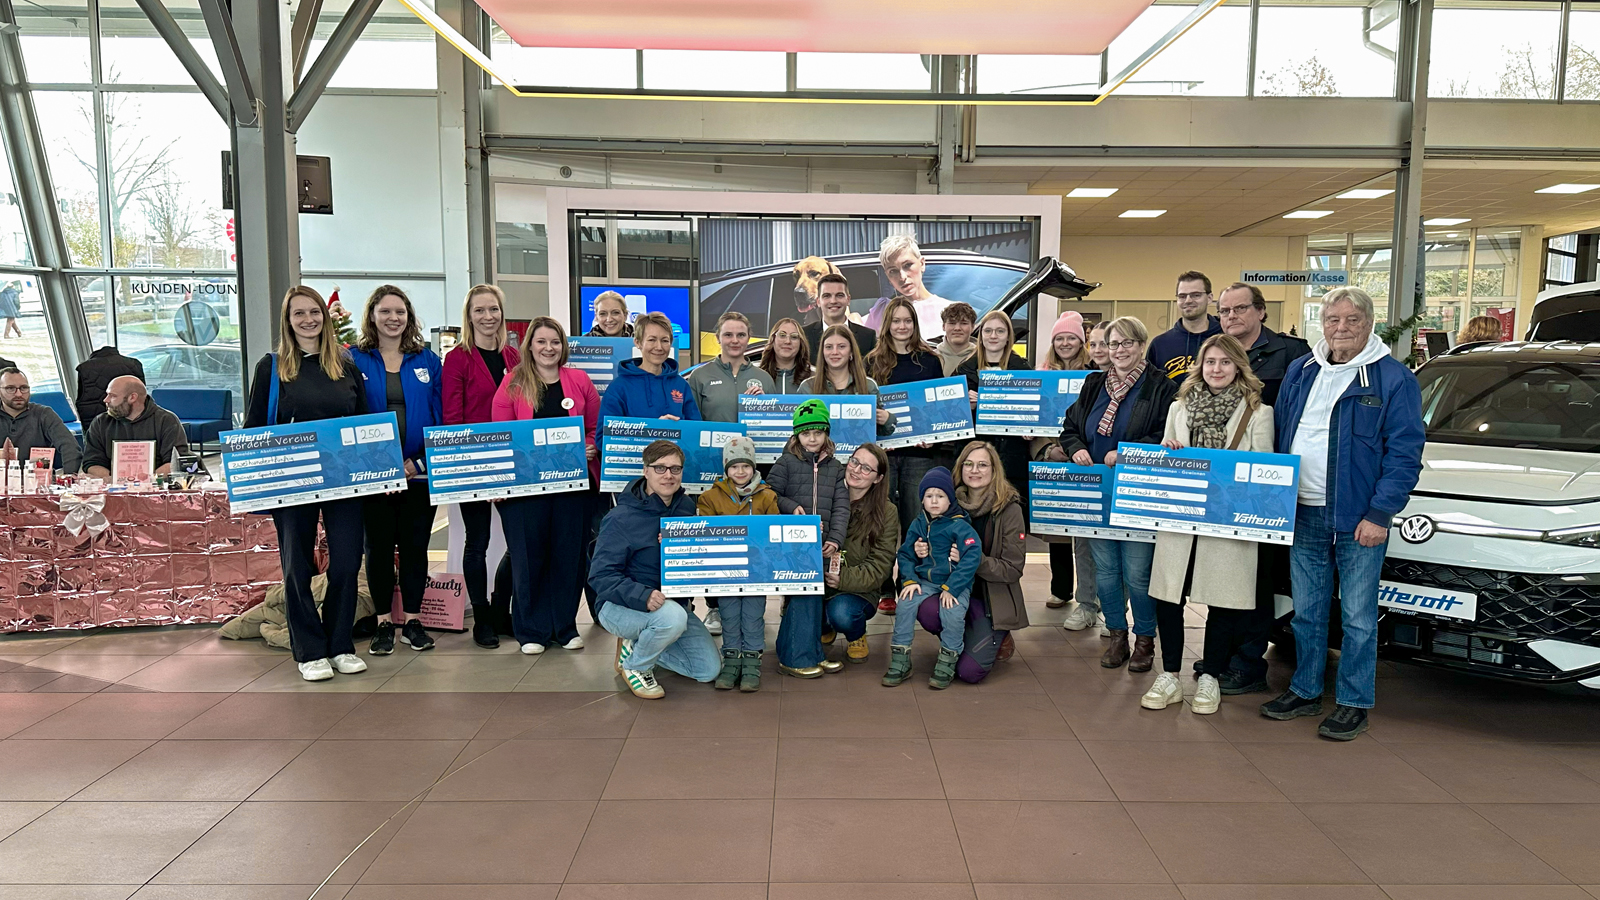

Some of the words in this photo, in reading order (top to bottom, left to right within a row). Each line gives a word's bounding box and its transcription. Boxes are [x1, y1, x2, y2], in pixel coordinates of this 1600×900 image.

[741, 397, 779, 406] Vatterott
[607, 420, 648, 430] Vatterott
[931, 420, 968, 431] Vatterott
[224, 430, 274, 444] Vatterott
[428, 428, 474, 439] Vatterott
[474, 433, 510, 442] Vereine
[275, 434, 315, 445] Vereine
[1121, 446, 1169, 458] Vatterott
[1168, 458, 1208, 469] Vereine
[349, 467, 399, 482] Vatterott
[539, 468, 583, 480] Vatterott
[1031, 466, 1069, 474] Vatterott
[664, 520, 709, 530] Vatterott
[1233, 512, 1288, 527] Vatterott
[709, 527, 746, 535] Vereine
[773, 570, 819, 580] Vatterott
[425, 576, 463, 597] Beauty
